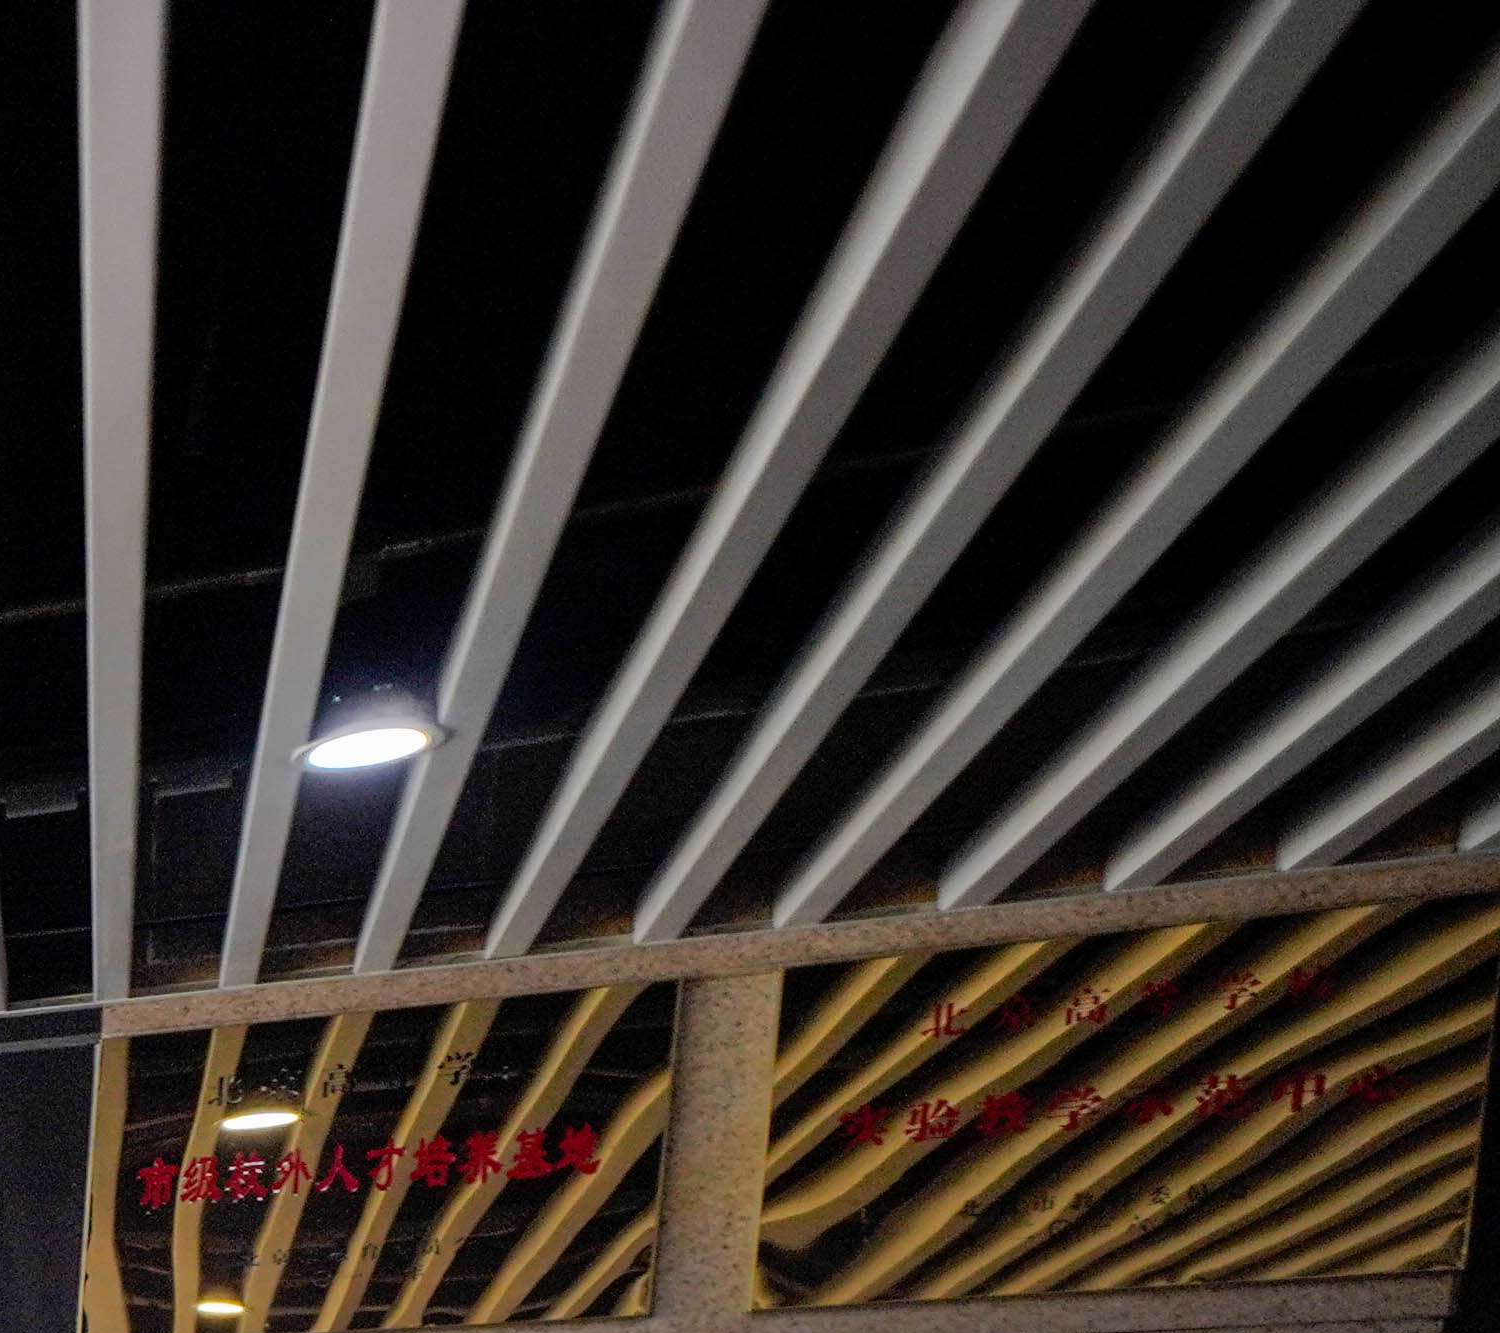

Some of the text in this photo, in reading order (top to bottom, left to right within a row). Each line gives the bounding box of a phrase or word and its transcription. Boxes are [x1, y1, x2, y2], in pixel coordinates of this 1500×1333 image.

[136, 1123, 602, 1209] 市级校外人才培养基地
